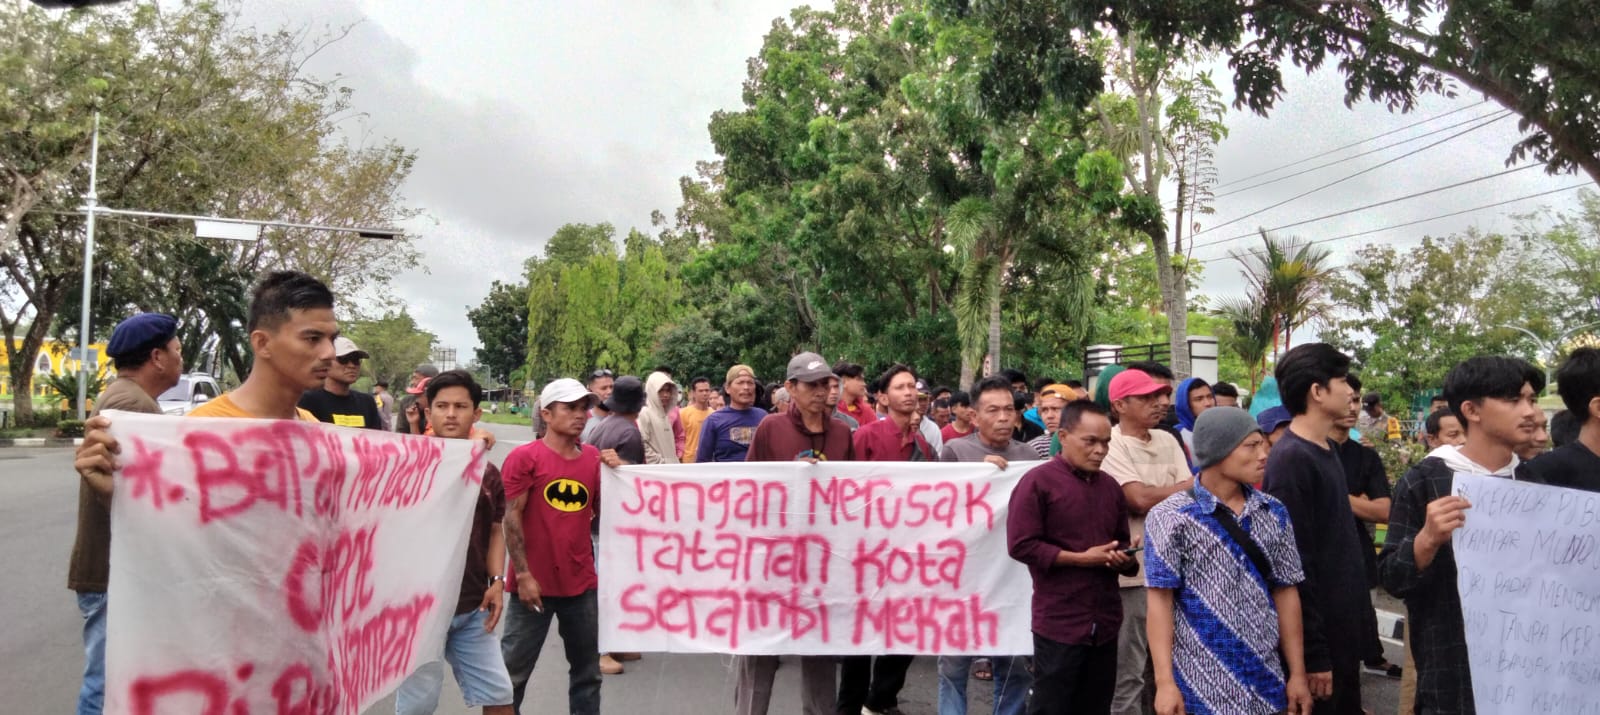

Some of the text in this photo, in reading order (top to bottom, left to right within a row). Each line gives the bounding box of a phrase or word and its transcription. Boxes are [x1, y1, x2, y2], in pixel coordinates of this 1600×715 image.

[621, 476, 995, 532] Jangan Merusak
[615, 525, 968, 596] Tatanan Kota
[618, 583, 1000, 654] Serambi Mekah
